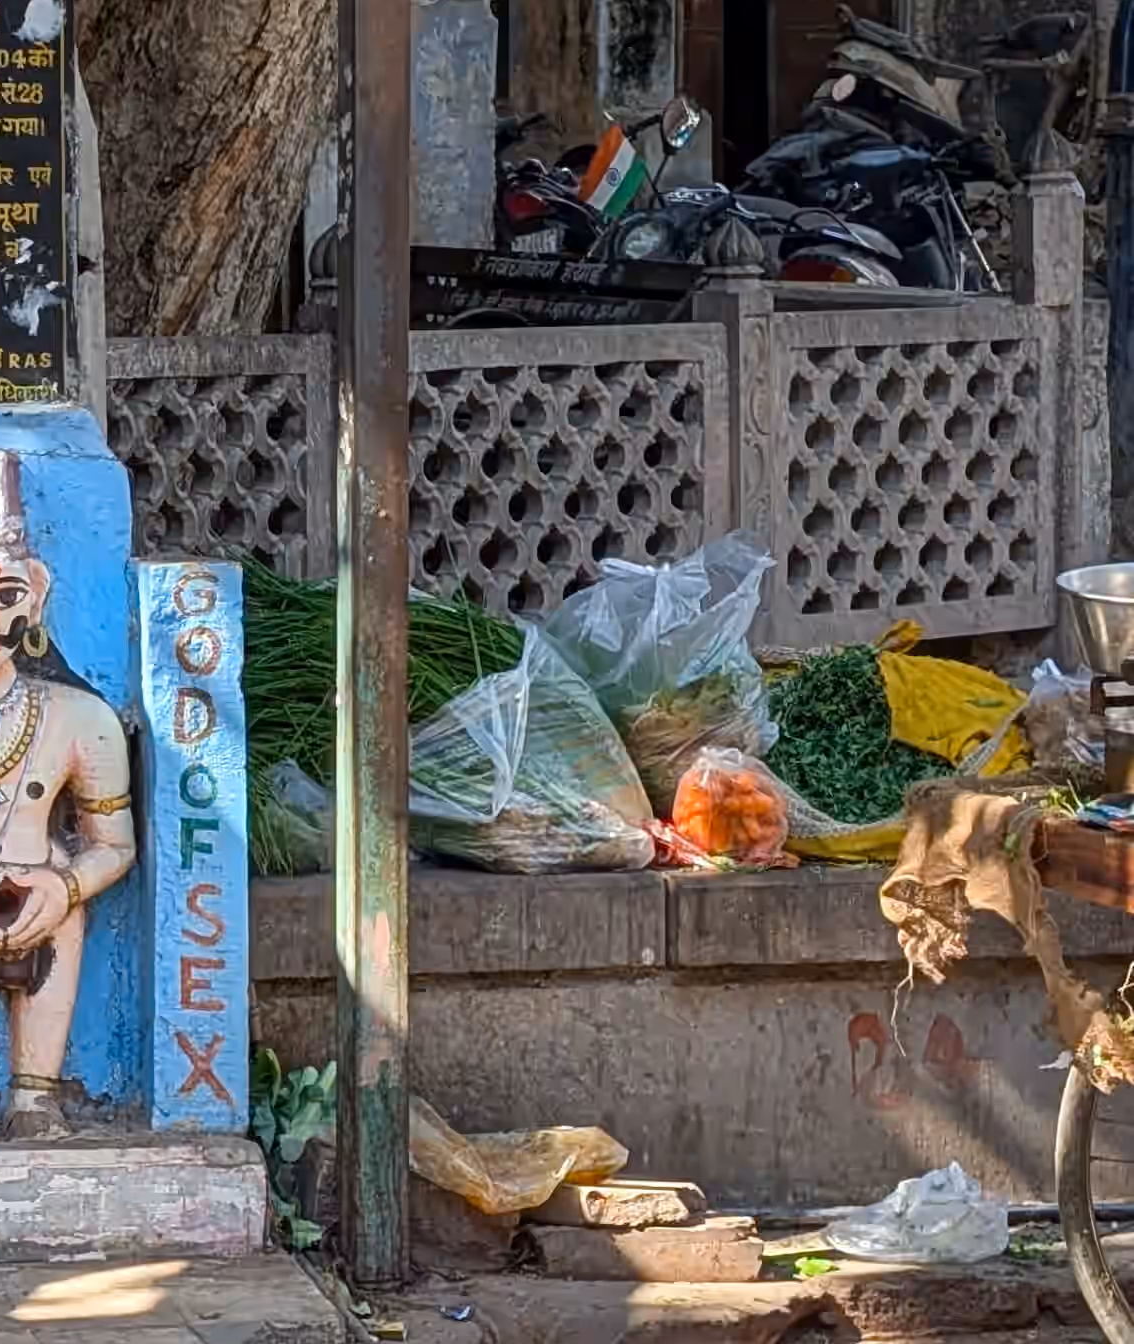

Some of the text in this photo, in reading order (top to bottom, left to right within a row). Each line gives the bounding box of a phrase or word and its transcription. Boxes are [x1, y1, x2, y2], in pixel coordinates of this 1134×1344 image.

[28, 41, 55, 68] को
[26, 161, 52, 189] एवं
[173, 569, 236, 1109] GOD OF SEX
